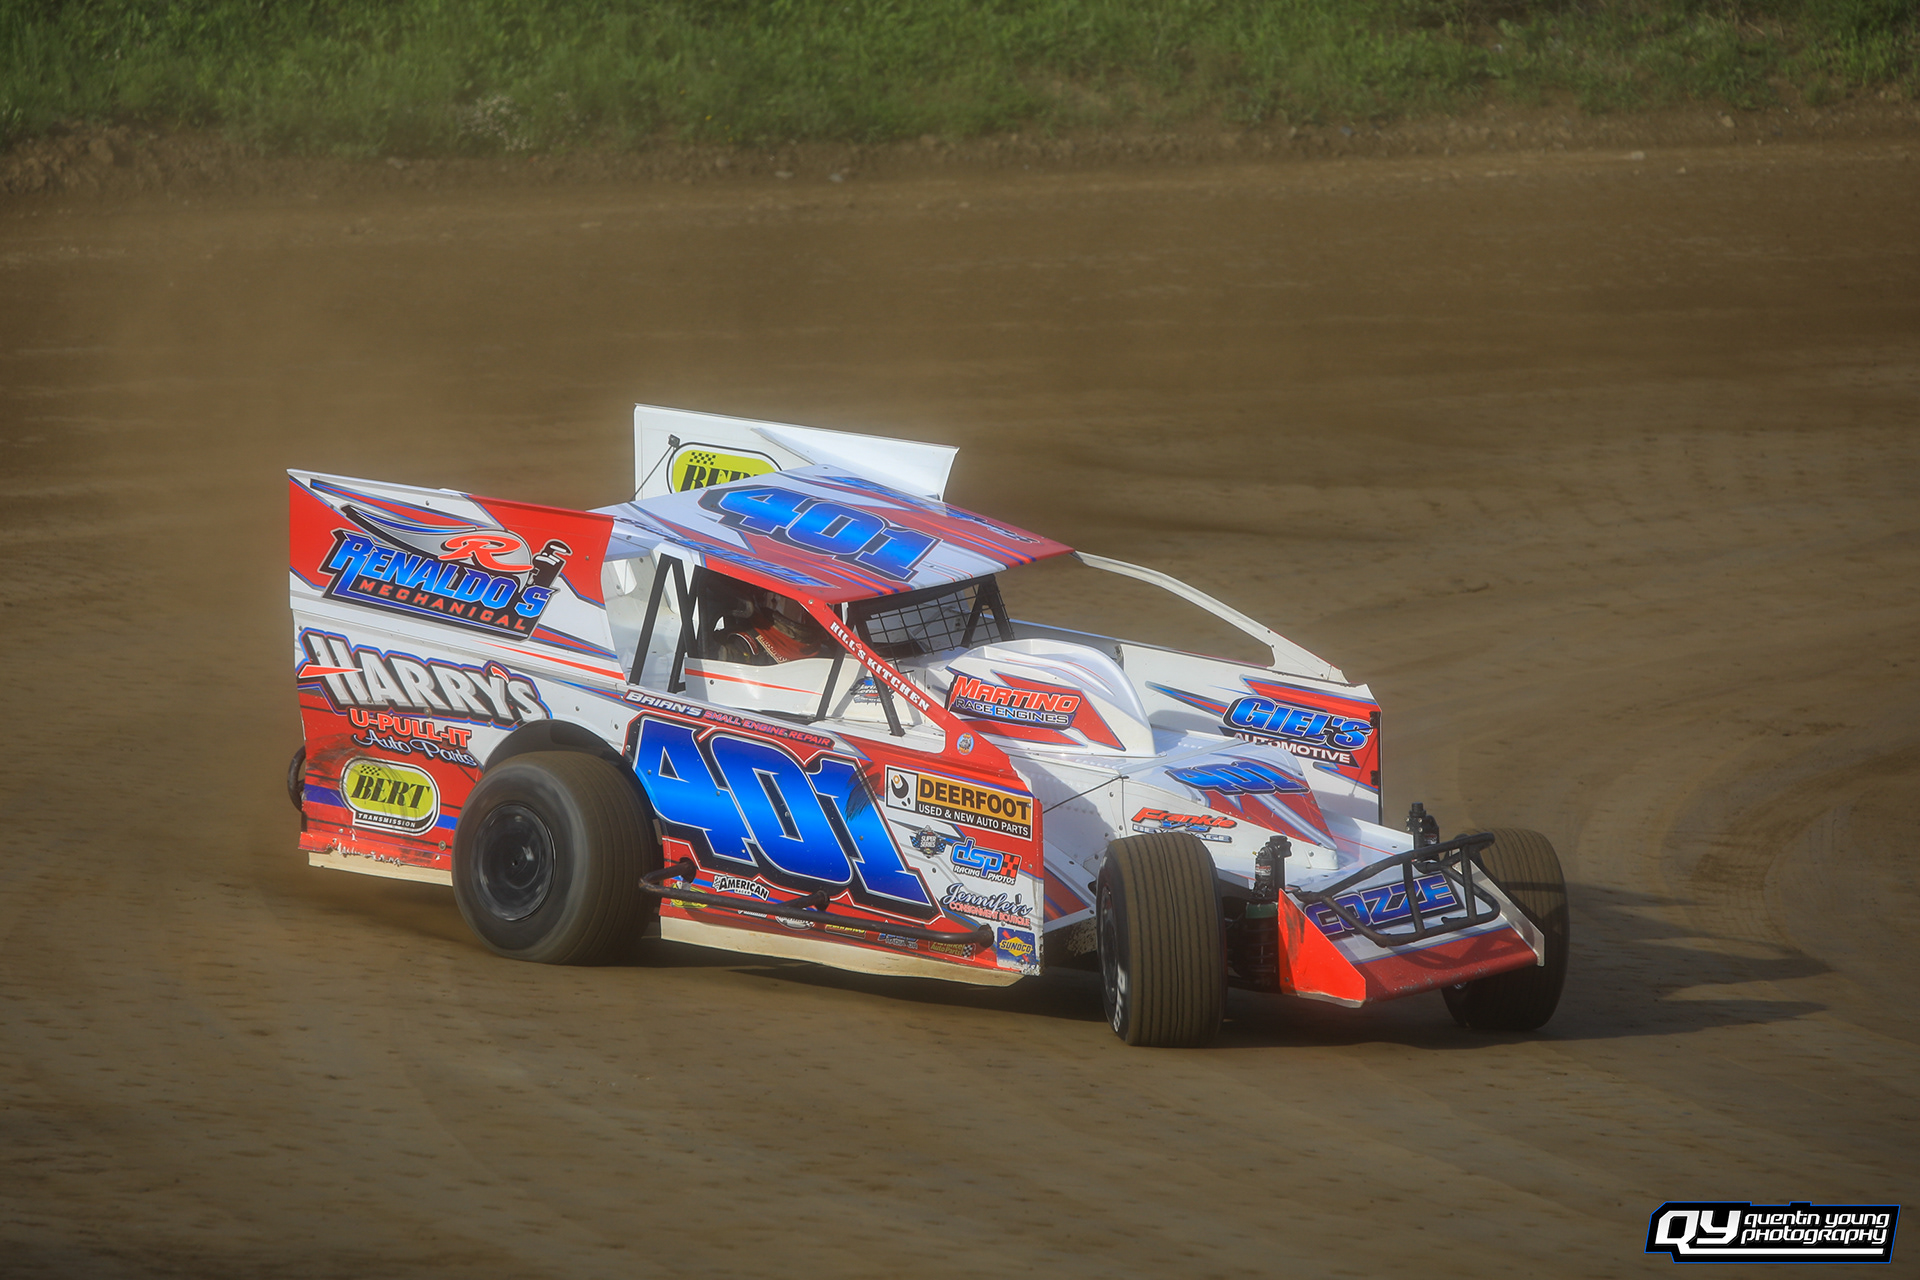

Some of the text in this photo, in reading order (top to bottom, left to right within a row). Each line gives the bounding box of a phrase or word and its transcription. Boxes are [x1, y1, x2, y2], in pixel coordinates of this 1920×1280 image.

[680, 464, 760, 492] BE
[717, 486, 945, 582] 401
[437, 534, 534, 572] R
[359, 579, 526, 631] MECHANICAL
[306, 634, 541, 721] HARRY'S
[830, 621, 866, 660] HILL'S
[867, 657, 930, 711] KITCHEN
[952, 676, 1081, 713] MARTINO
[956, 700, 1069, 725] RACE ENGINES
[350, 708, 472, 748] U-PULL-IT
[625, 691, 831, 747] BRIAN'S SMALL ENGINE REPAIR
[1230, 696, 1373, 748] GIEL'S
[353, 729, 478, 767] Auto Parts
[351, 775, 430, 809] BERT
[1168, 762, 1309, 794] 401
[632, 717, 932, 906] 401
[919, 778, 1032, 821] DEERFOOT
[1131, 807, 1237, 828] Frankie
[358, 813, 416, 828] TRANSMISSION
[918, 803, 1028, 836] USED & NEW AUTO PARTS
[952, 840, 1003, 878] dsp
[954, 865, 1015, 885] RACING PHOTOS
[719, 877, 768, 899] AMERICAN
[942, 882, 1033, 916] Jennifer's
[949, 901, 1031, 927] CONSIGNMENT BOUTIQUE
[1001, 940, 1032, 953] SUNOCO
